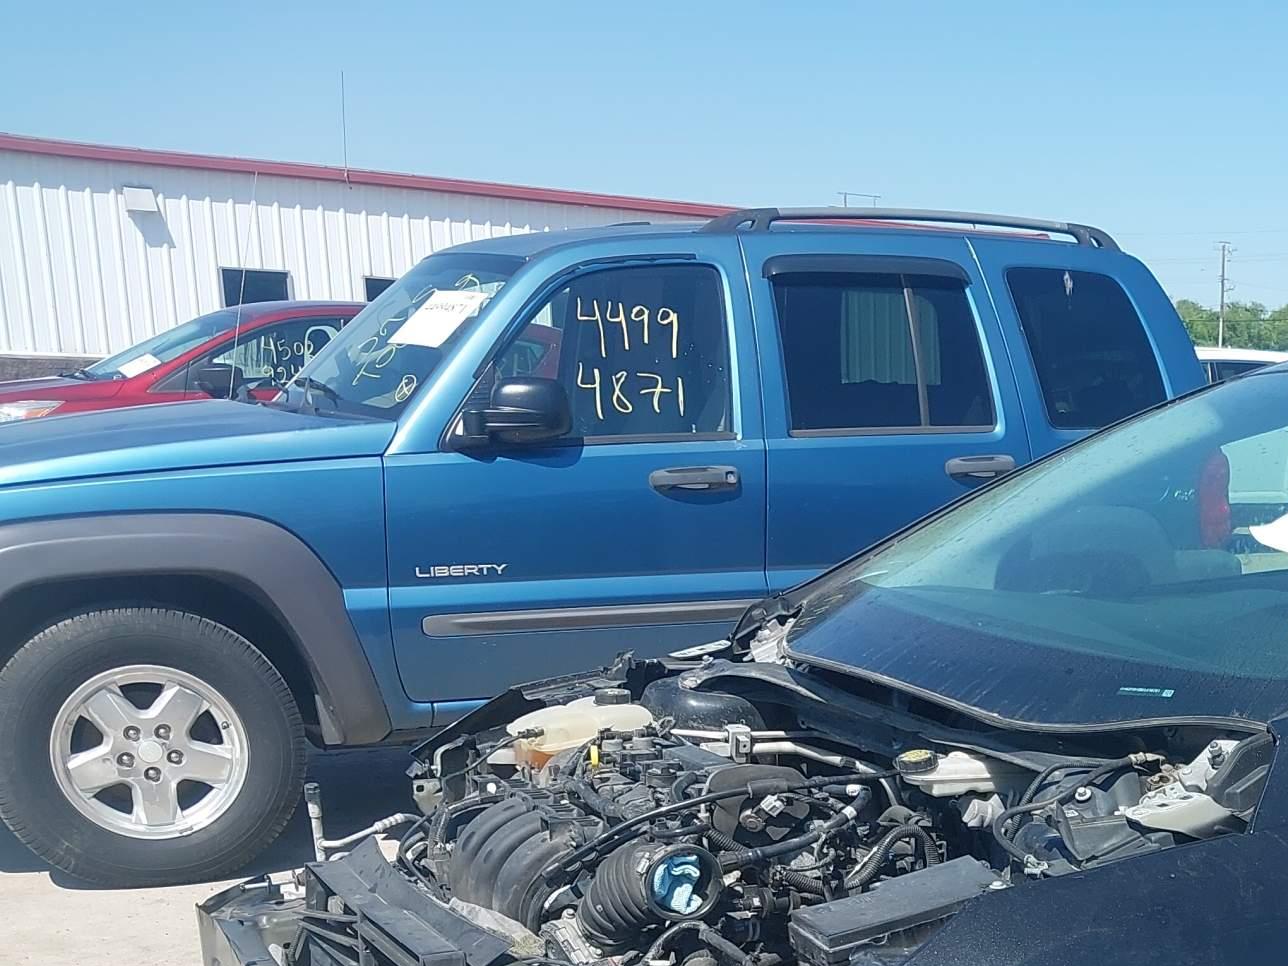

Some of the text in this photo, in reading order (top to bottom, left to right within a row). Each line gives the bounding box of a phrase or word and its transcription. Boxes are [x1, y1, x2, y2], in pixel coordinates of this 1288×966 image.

[577, 296, 678, 358] 4499
[577, 362, 684, 420] 4871
[415, 563, 508, 577] LIBERTY
